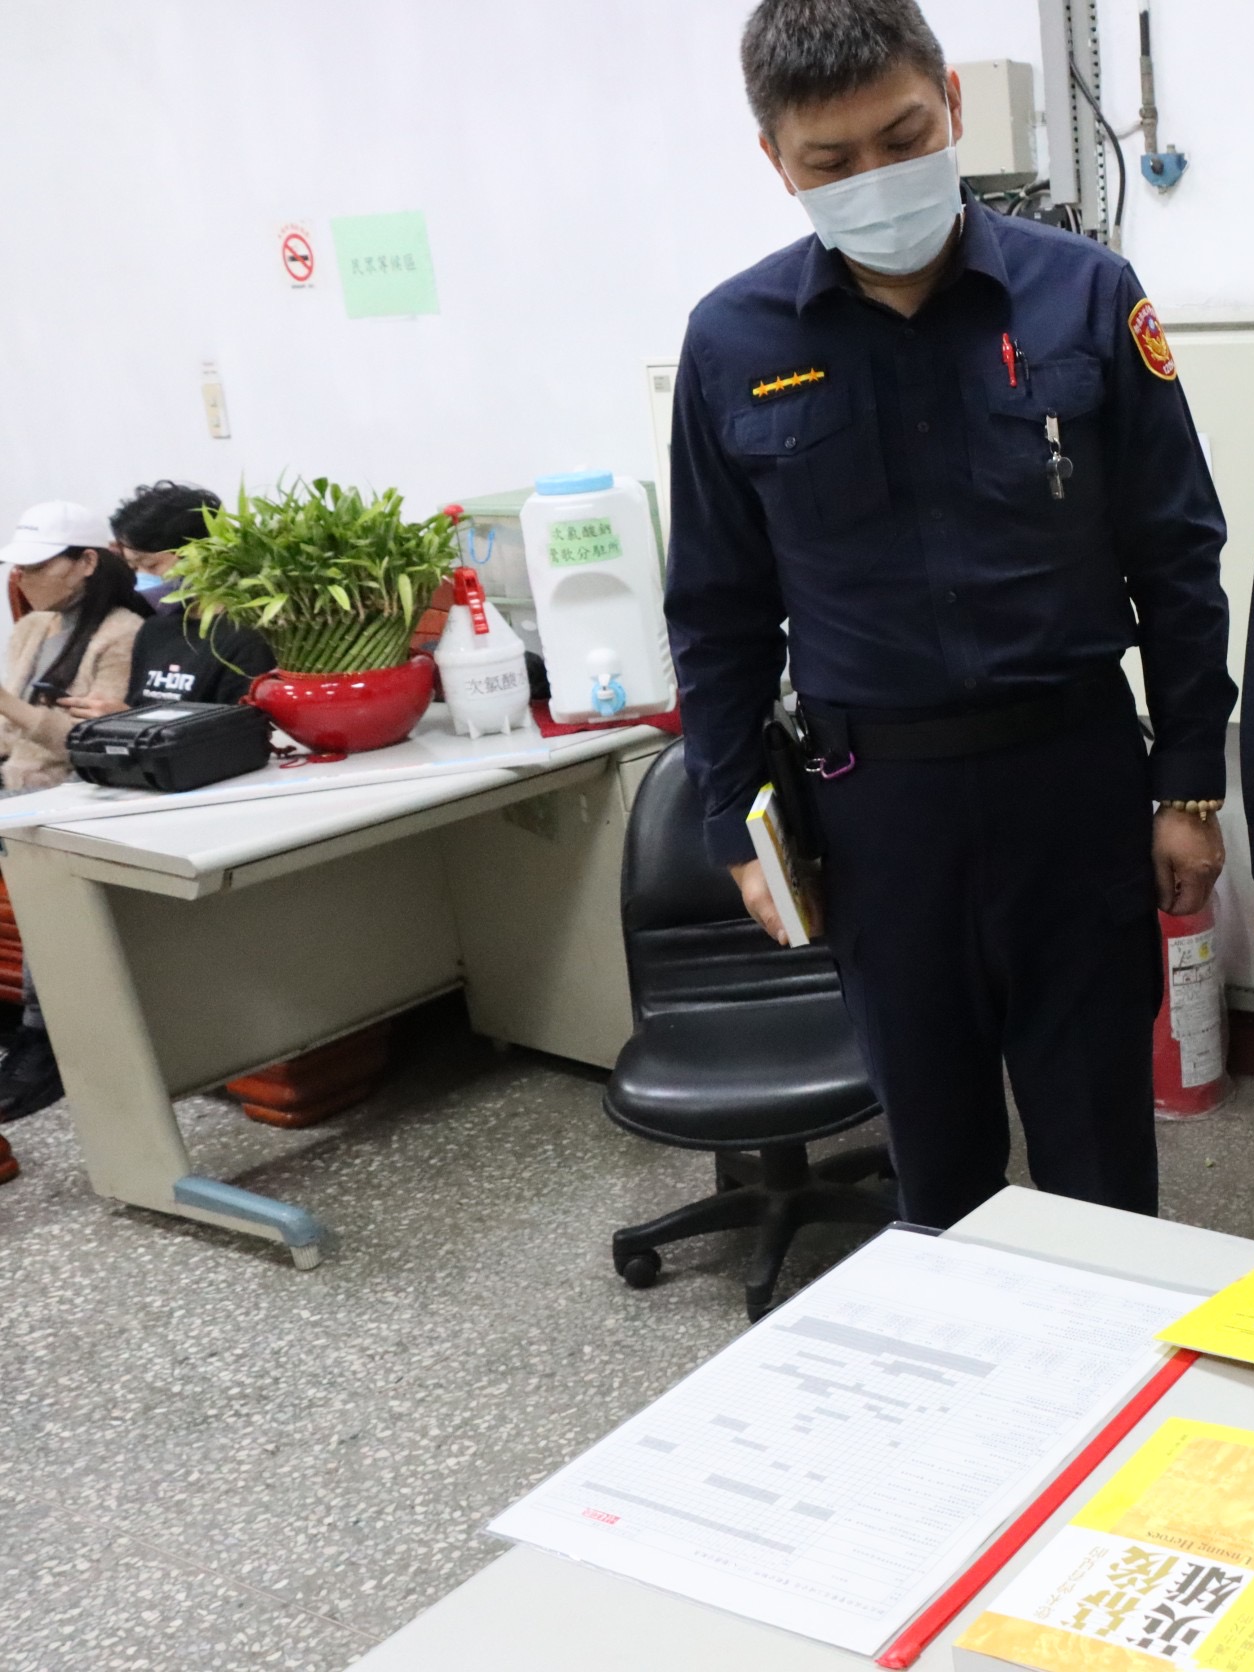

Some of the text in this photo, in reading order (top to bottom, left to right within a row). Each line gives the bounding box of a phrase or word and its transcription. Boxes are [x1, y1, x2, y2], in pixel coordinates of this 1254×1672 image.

[146, 670, 195, 691] THOR
[1147, 1530, 1253, 1566] Unsung Heroes
[1125, 1562, 1244, 1656] 英雄
